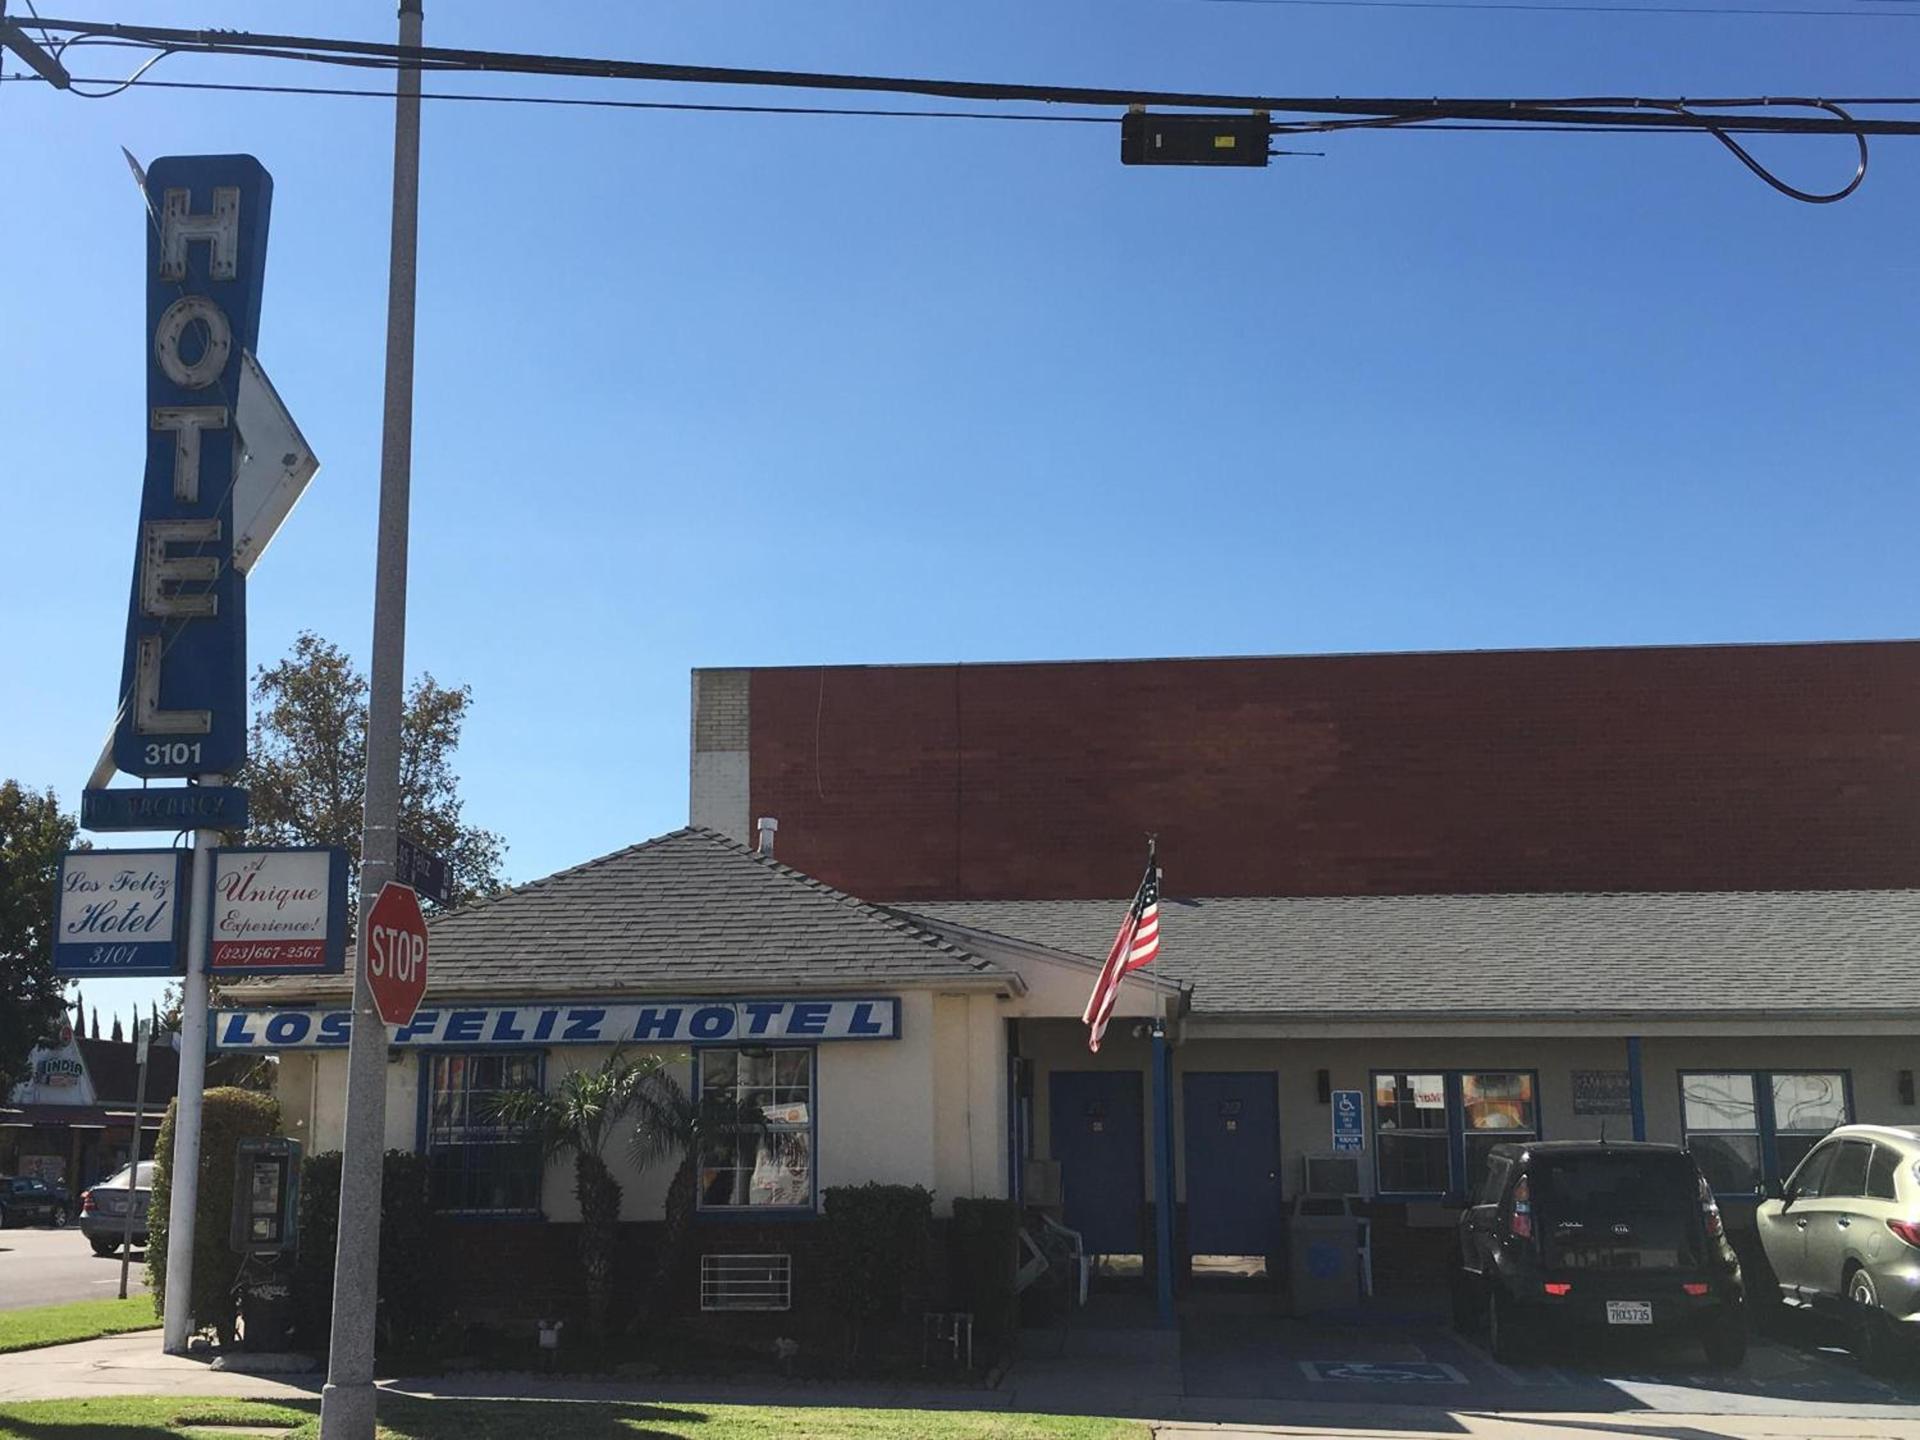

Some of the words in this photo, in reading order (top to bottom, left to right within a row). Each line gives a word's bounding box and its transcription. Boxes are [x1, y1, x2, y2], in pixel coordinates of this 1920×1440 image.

[135, 186, 240, 735] HOTEL
[144, 742, 201, 765] 3101
[64, 871, 100, 893] Los
[109, 870, 169, 900] Feliz
[216, 871, 321, 910] Unique
[68, 899, 168, 934] Hotel
[220, 909, 320, 938] Experience!
[89, 946, 138, 963] 3101
[216, 943, 321, 963] (323)667-2567
[371, 924, 424, 983] STOP
[223, 1012, 352, 1045] LOS
[394, 1008, 606, 1042] FELIZ
[633, 1003, 882, 1040] HOTEL
